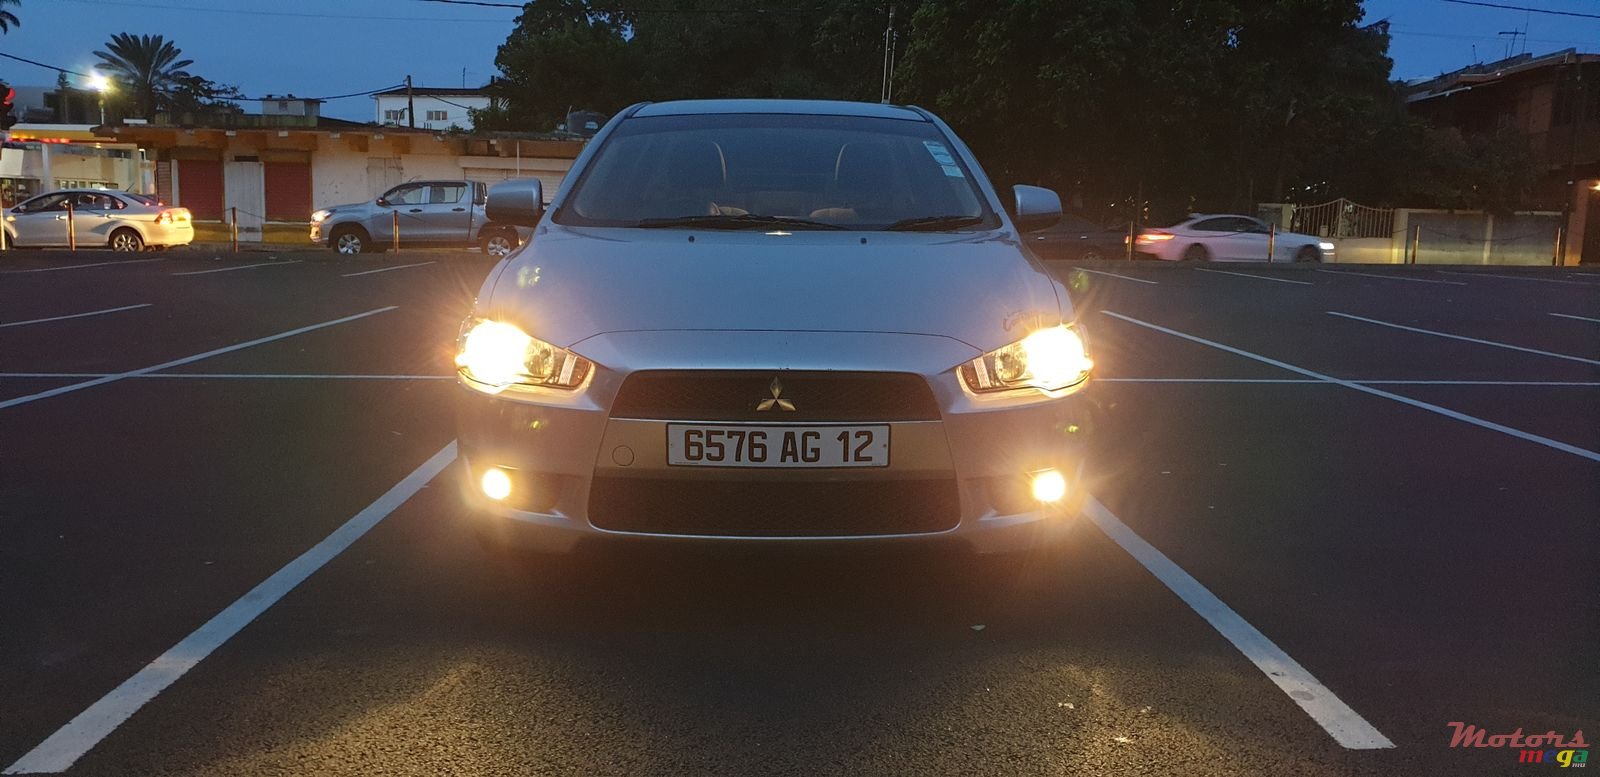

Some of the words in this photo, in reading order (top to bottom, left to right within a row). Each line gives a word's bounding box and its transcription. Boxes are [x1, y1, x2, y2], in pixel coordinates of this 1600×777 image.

[684, 429, 768, 463] 6576
[780, 431, 821, 463] AG
[837, 430, 873, 462] 12
